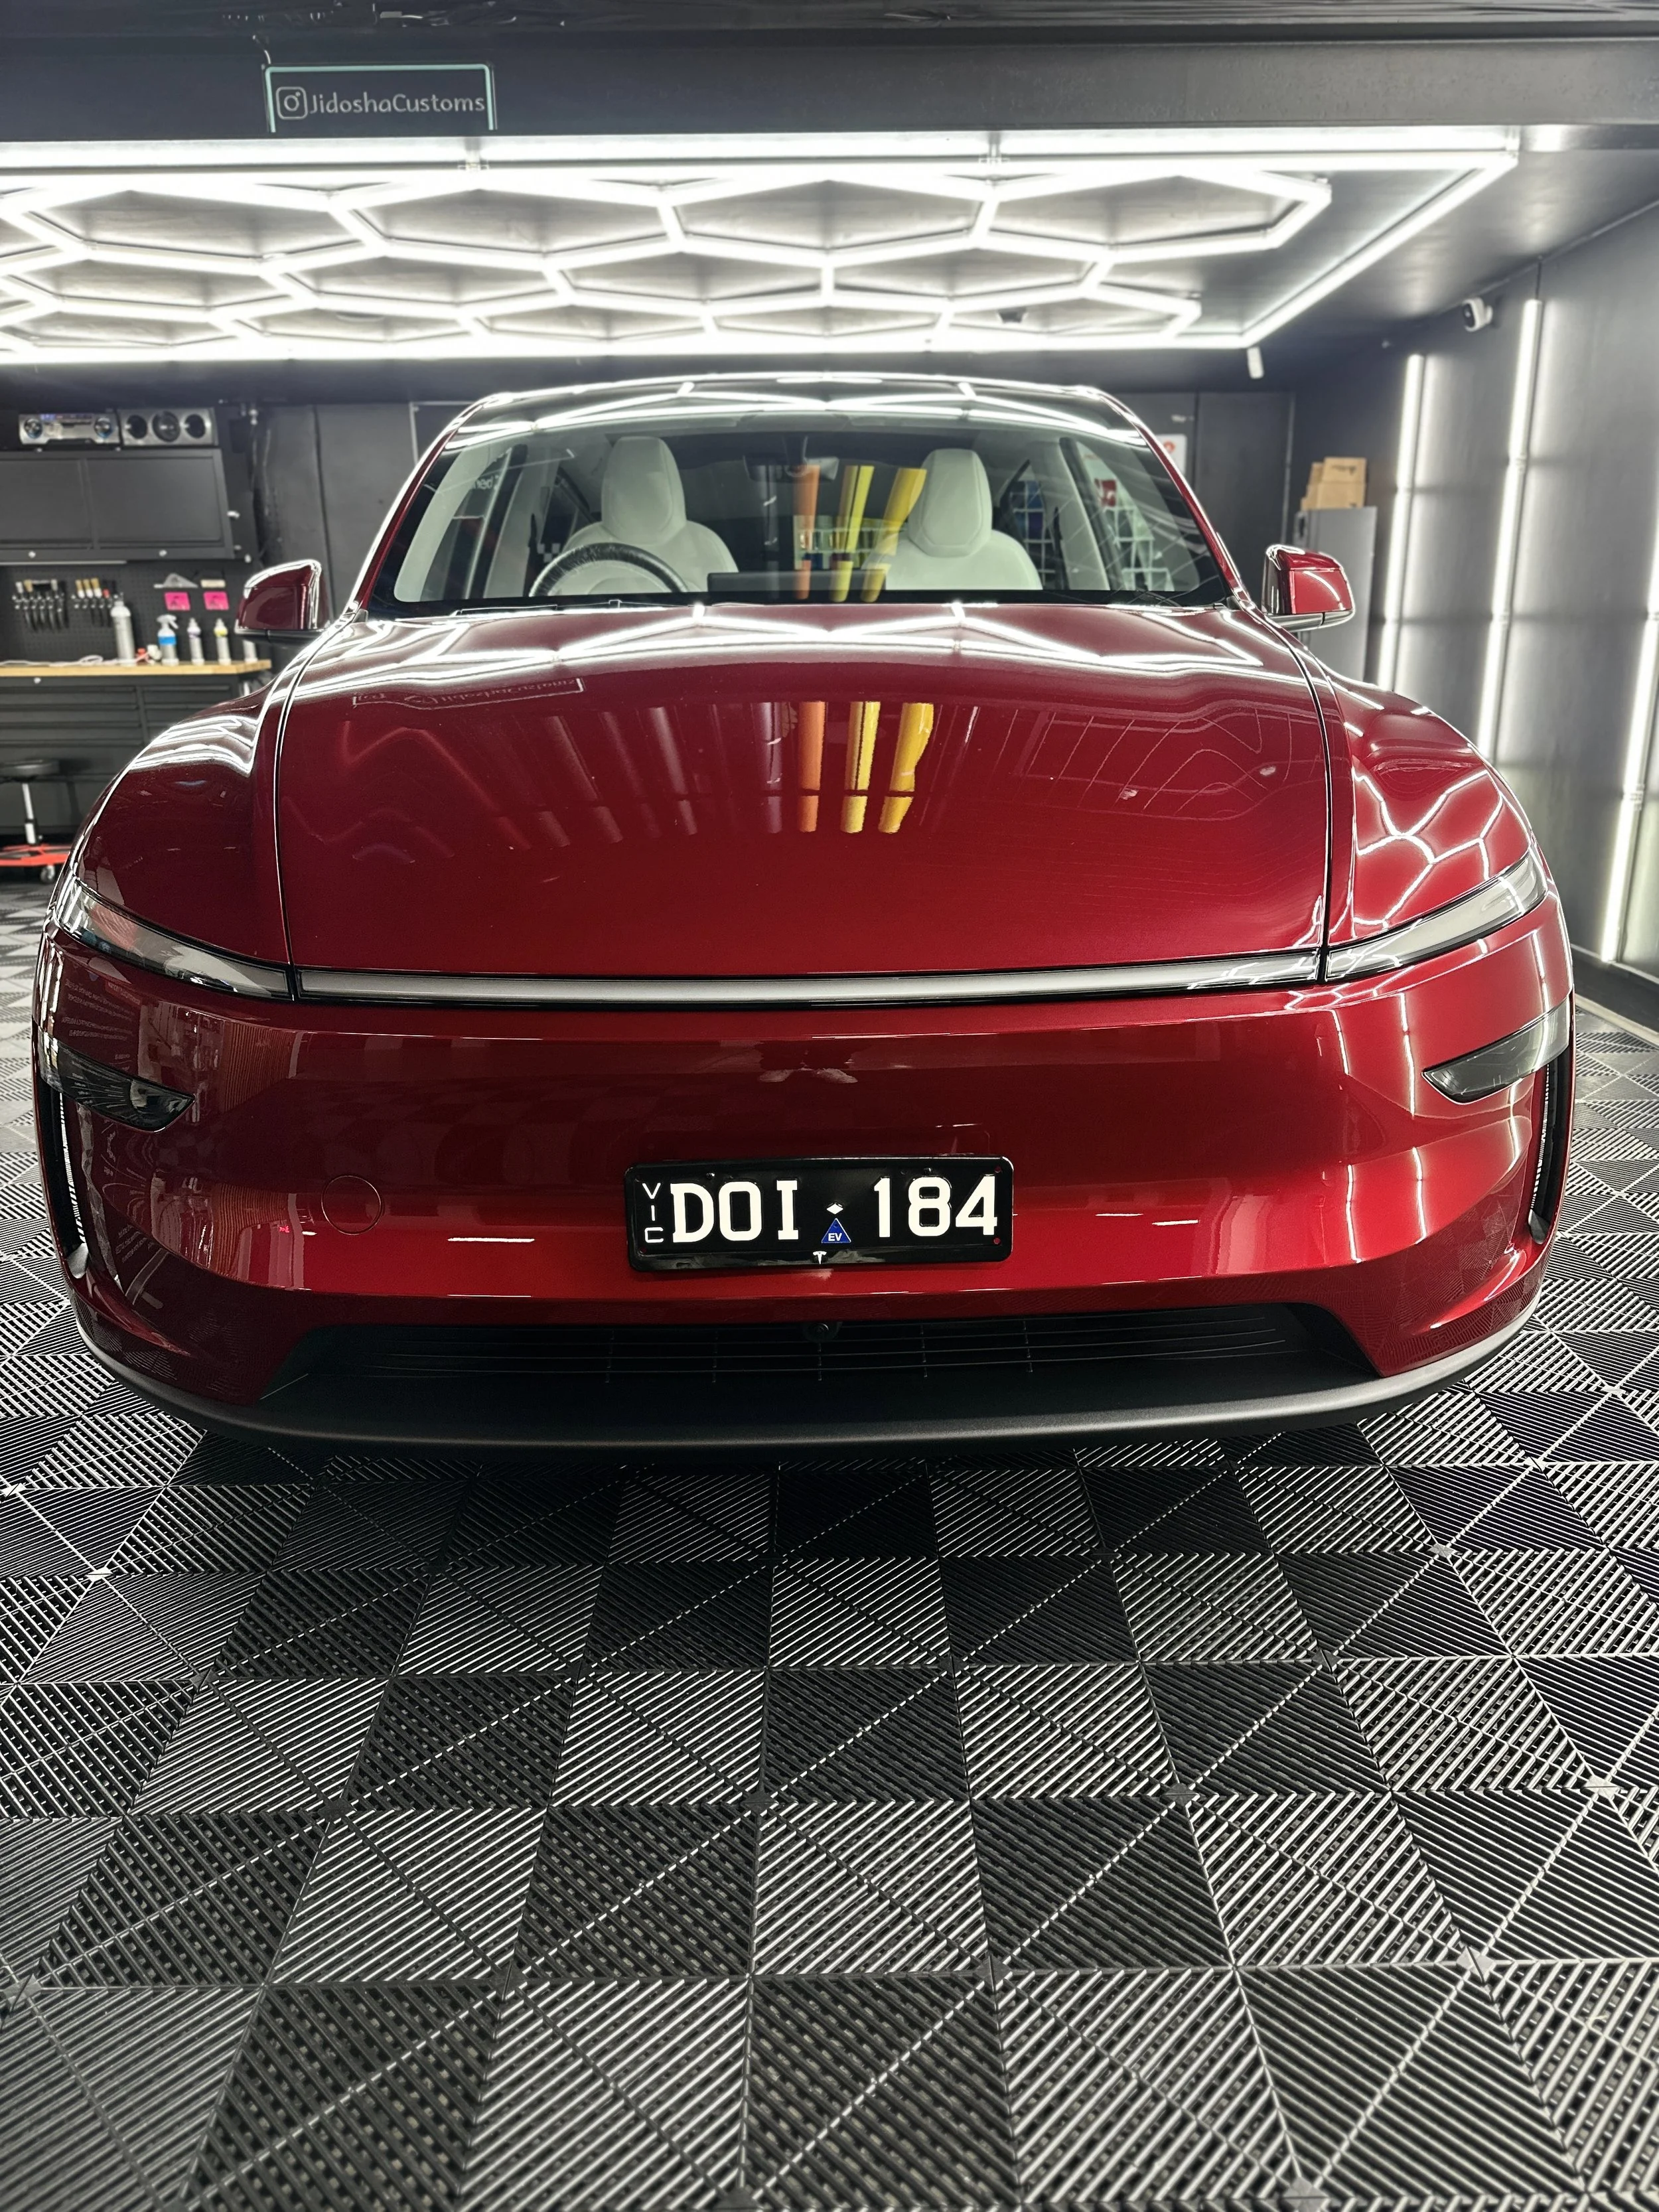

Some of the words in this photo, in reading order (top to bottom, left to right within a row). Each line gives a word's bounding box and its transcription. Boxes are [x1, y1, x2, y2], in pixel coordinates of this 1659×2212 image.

[309, 92, 485, 113] JidoshaCustoms
[642, 1182, 664, 1243] VIC
[873, 1175, 997, 1238] 184
[828, 1232, 843, 1242] EV
